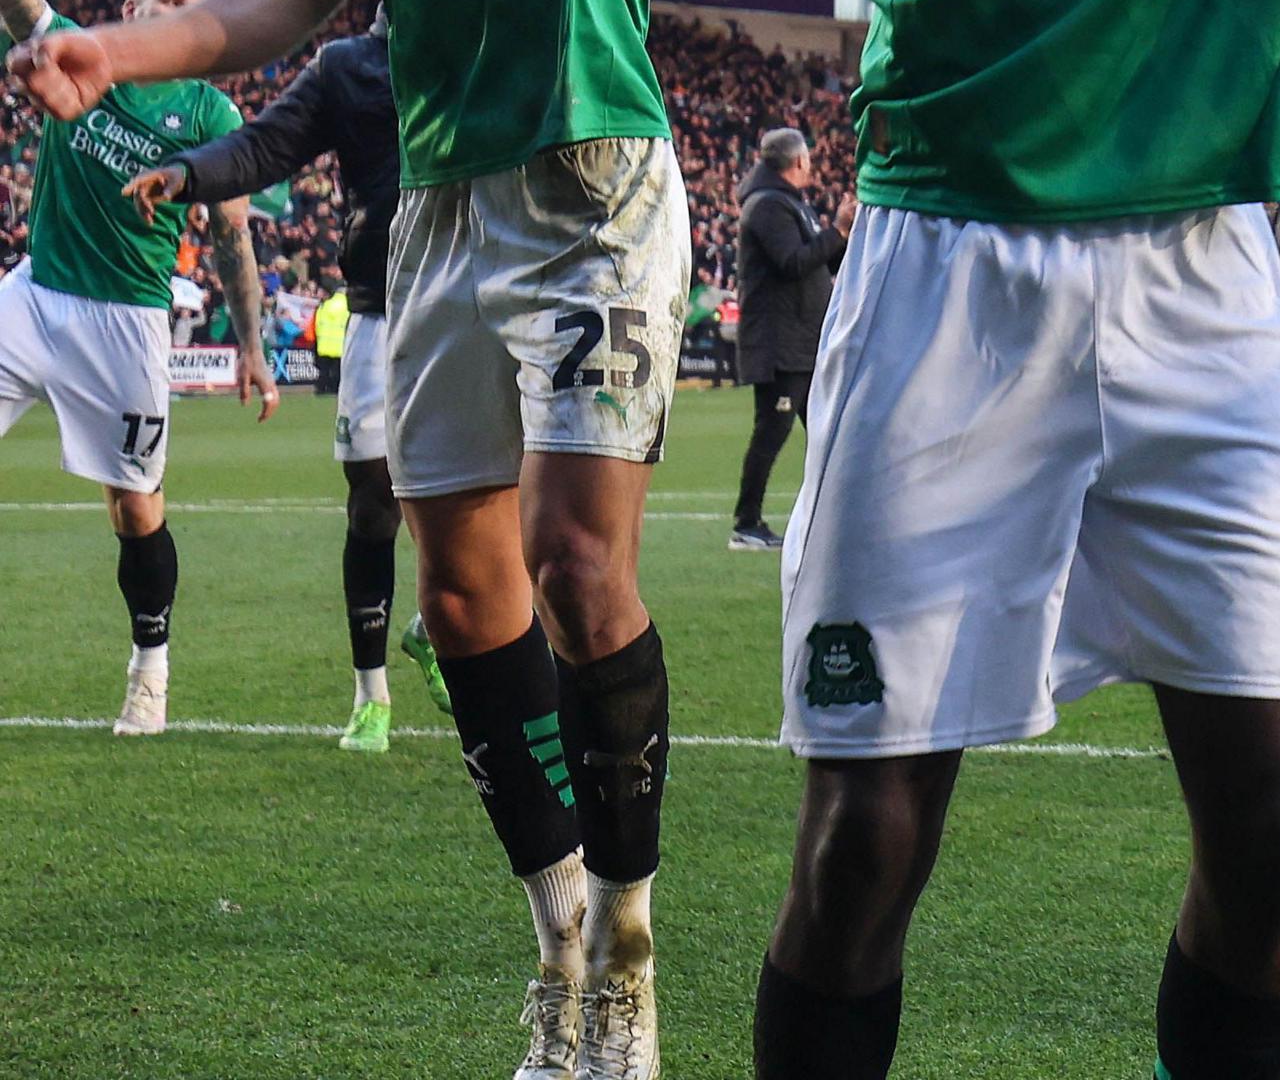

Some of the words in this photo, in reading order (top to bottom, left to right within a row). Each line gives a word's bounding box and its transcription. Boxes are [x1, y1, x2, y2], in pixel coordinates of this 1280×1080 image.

[86, 108, 163, 161] Classic
[553, 307, 651, 392] 25
[122, 412, 165, 458] 17
